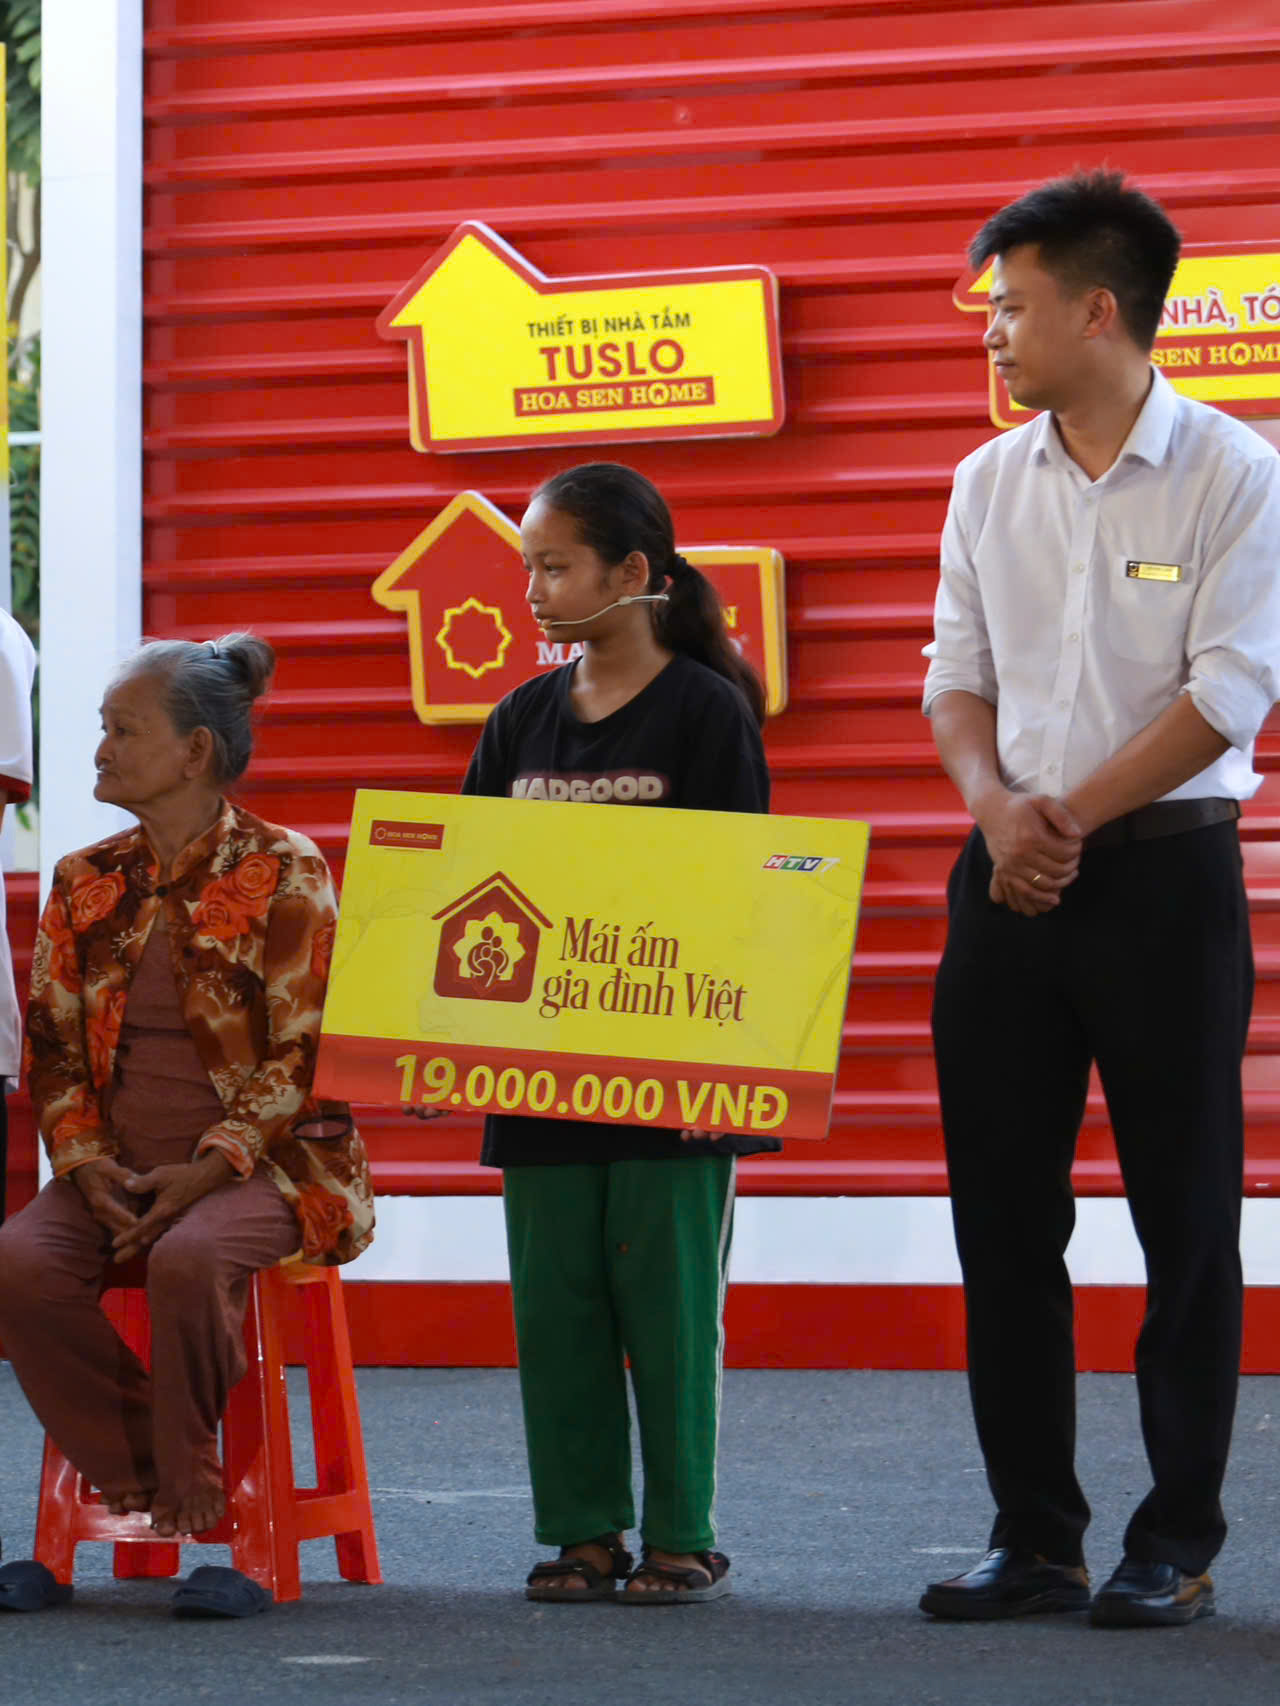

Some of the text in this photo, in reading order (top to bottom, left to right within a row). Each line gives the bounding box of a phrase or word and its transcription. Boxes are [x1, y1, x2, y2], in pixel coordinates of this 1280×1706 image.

[527, 314, 574, 338] THIẾT
[581, 318, 599, 339] BỊ
[604, 312, 646, 333] NHÀ
[539, 338, 685, 381] TUSLO
[1151, 342, 1280, 367] SEN HOM
[522, 382, 708, 412] HOA SEN HOME
[558, 916, 680, 969] Mái ấm
[539, 968, 748, 1027] gia đình Việt
[394, 1053, 789, 1130] 19.000.000 VNĐ
